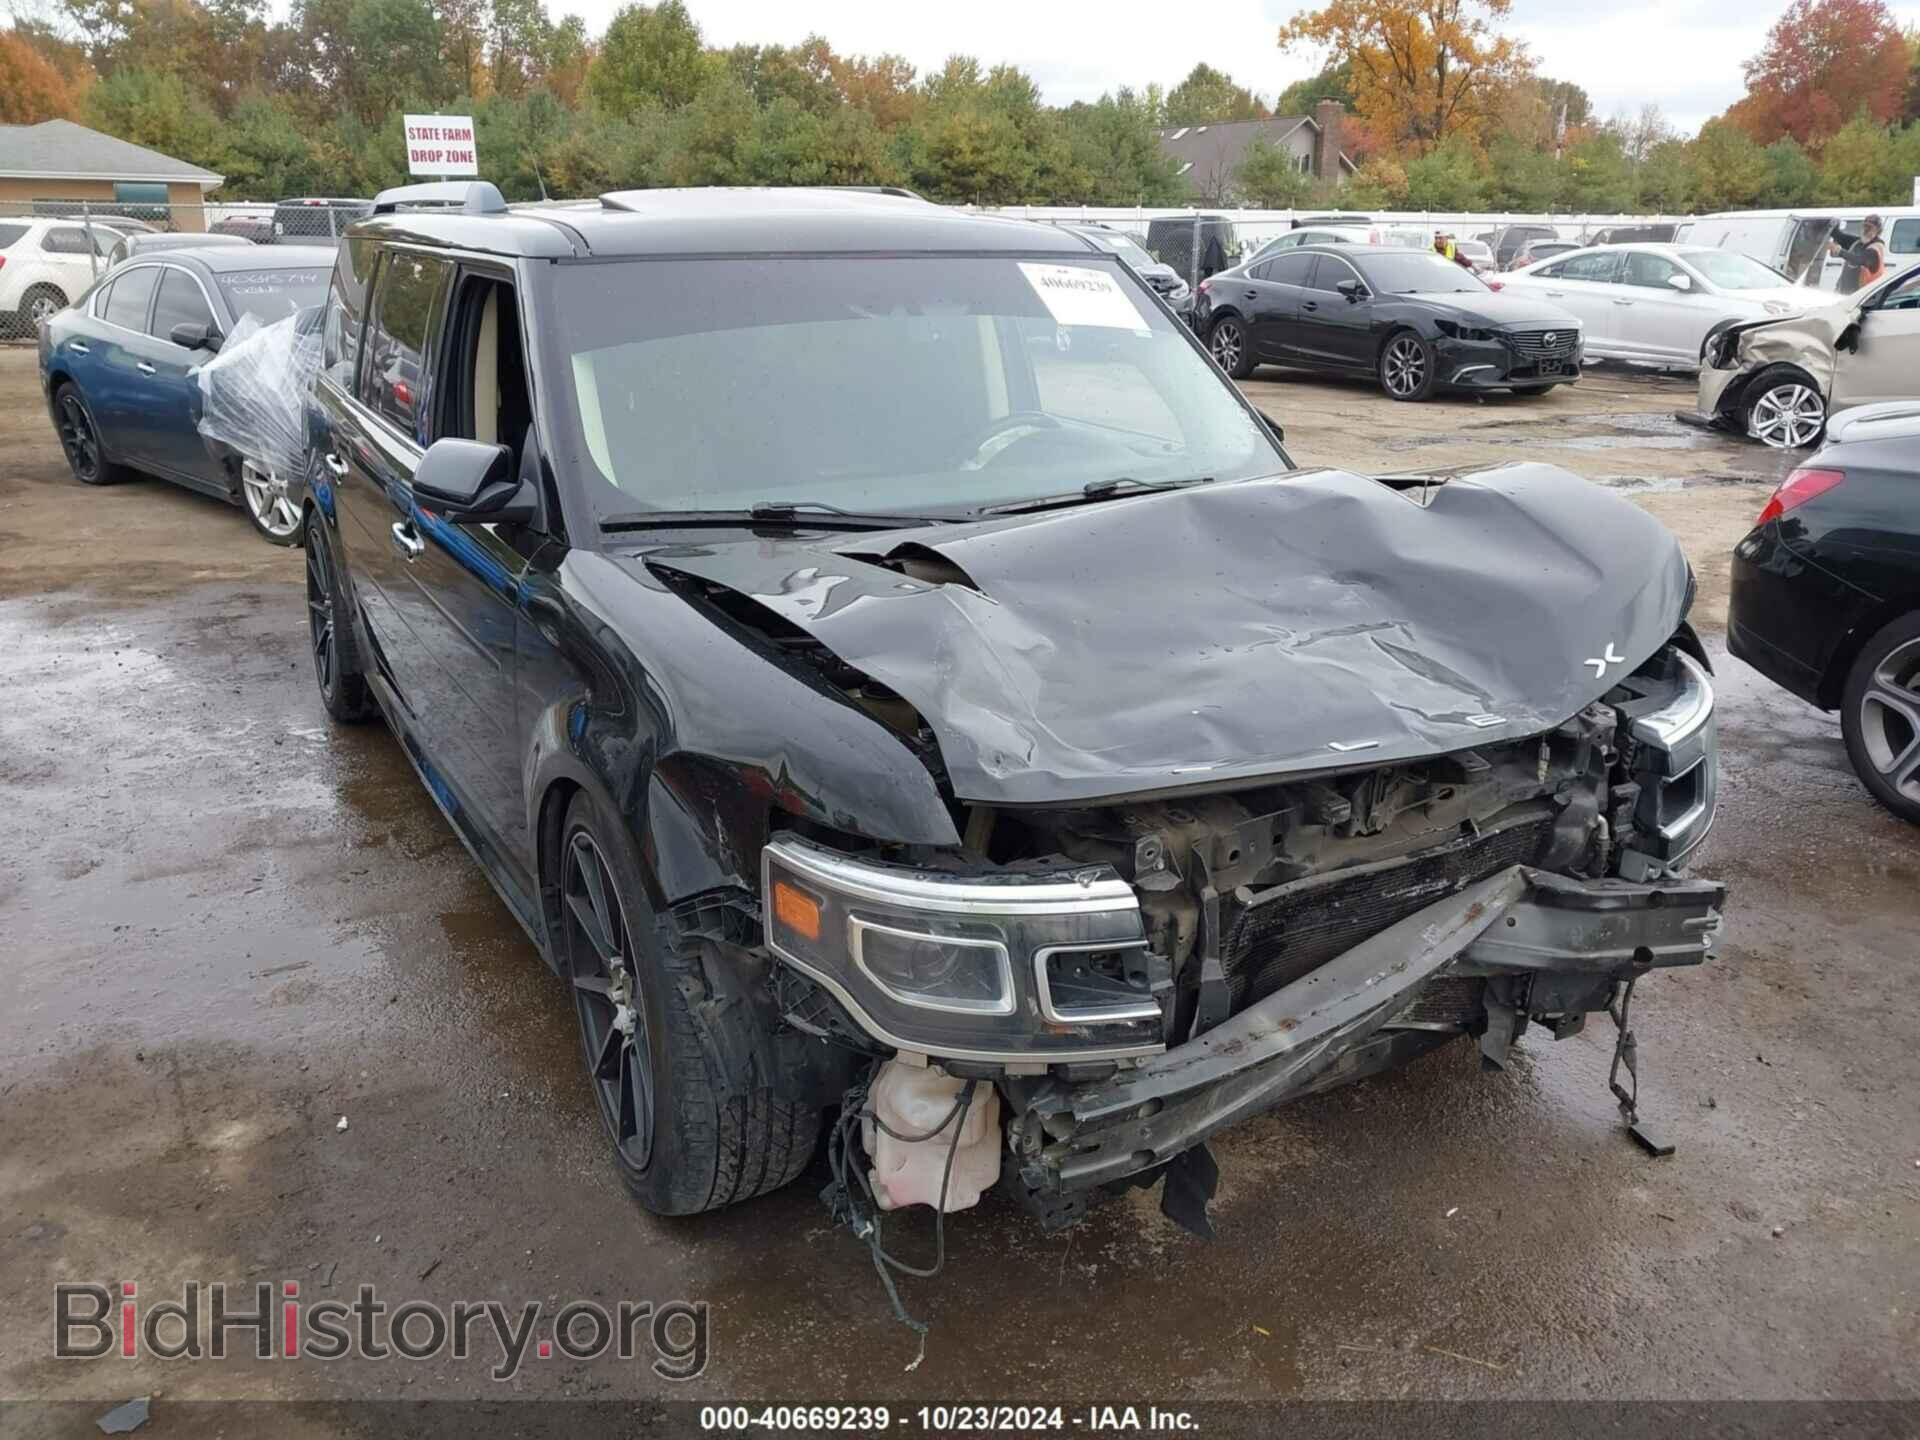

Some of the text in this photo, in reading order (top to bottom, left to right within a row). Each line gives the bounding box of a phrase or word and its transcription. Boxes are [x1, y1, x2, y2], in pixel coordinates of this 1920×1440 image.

[408, 127, 472, 141] STATE FARM
[411, 150, 474, 163] DROP ZONE
